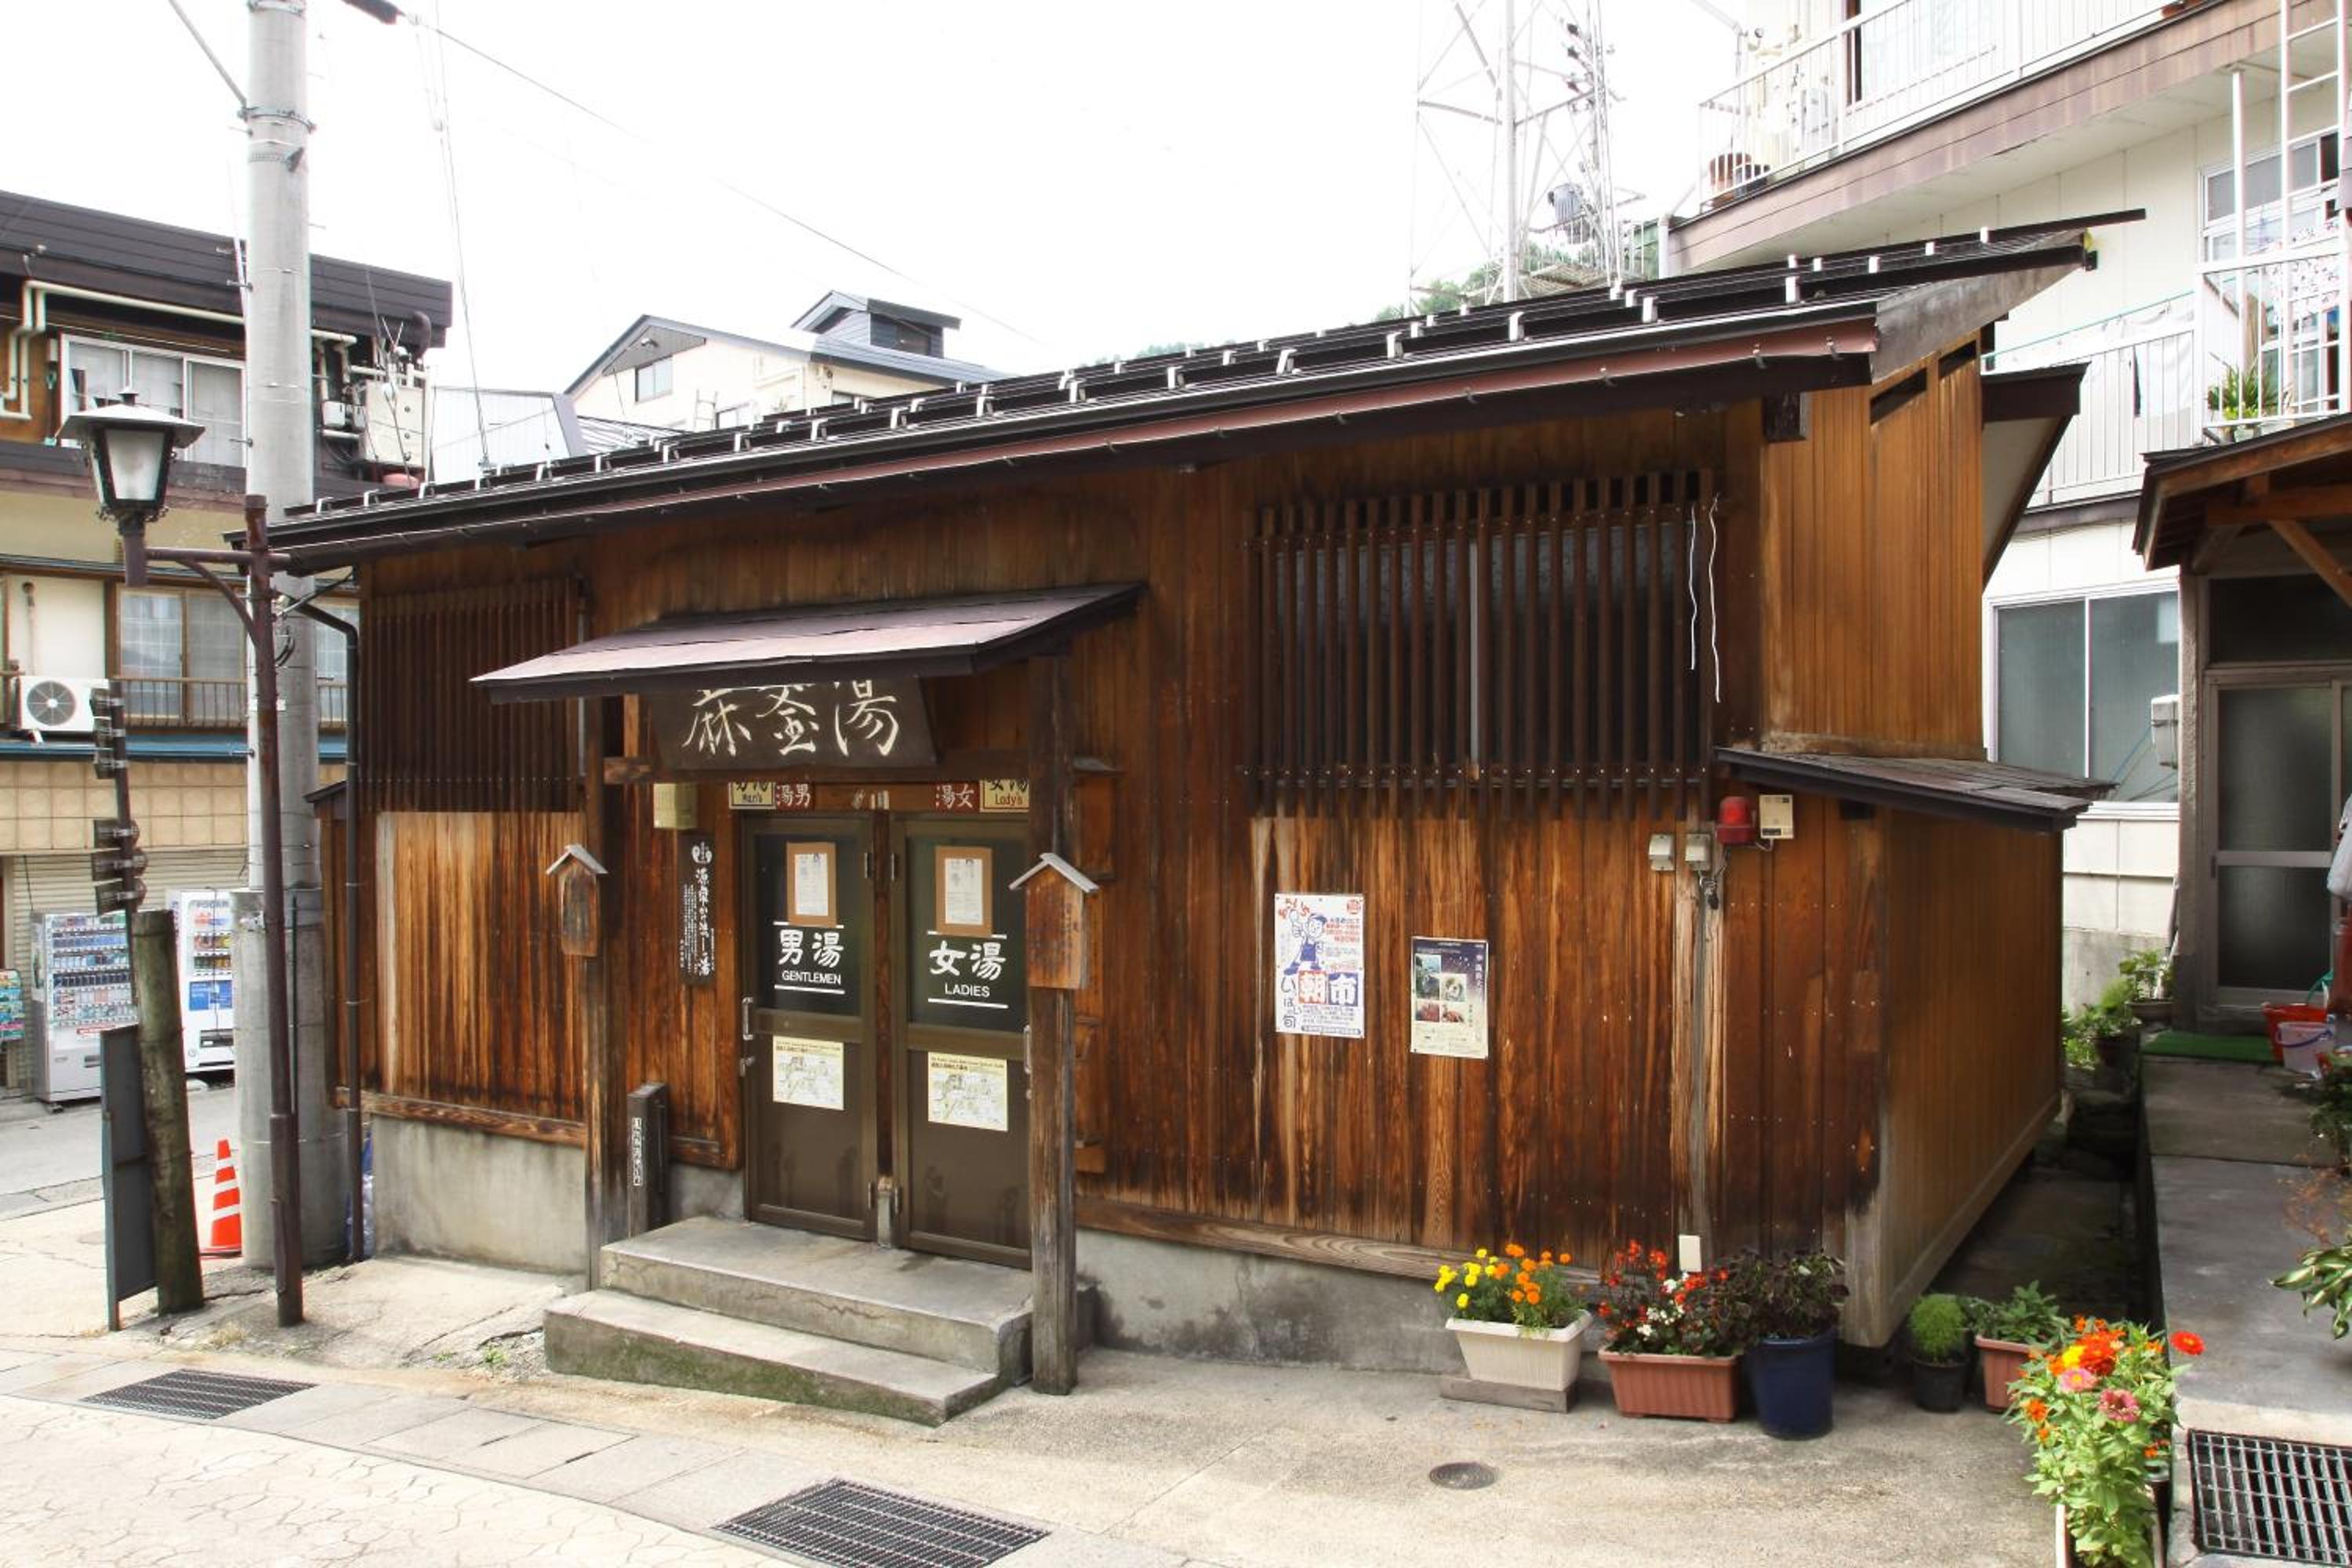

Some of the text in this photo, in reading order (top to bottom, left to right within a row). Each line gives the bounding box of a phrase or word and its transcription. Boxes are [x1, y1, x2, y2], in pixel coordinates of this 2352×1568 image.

[779, 929, 844, 968] 男湯
[929, 940, 1007, 981] 女湯
[782, 970, 841, 985] GENTLEMEN
[944, 982, 990, 998] LADIES
